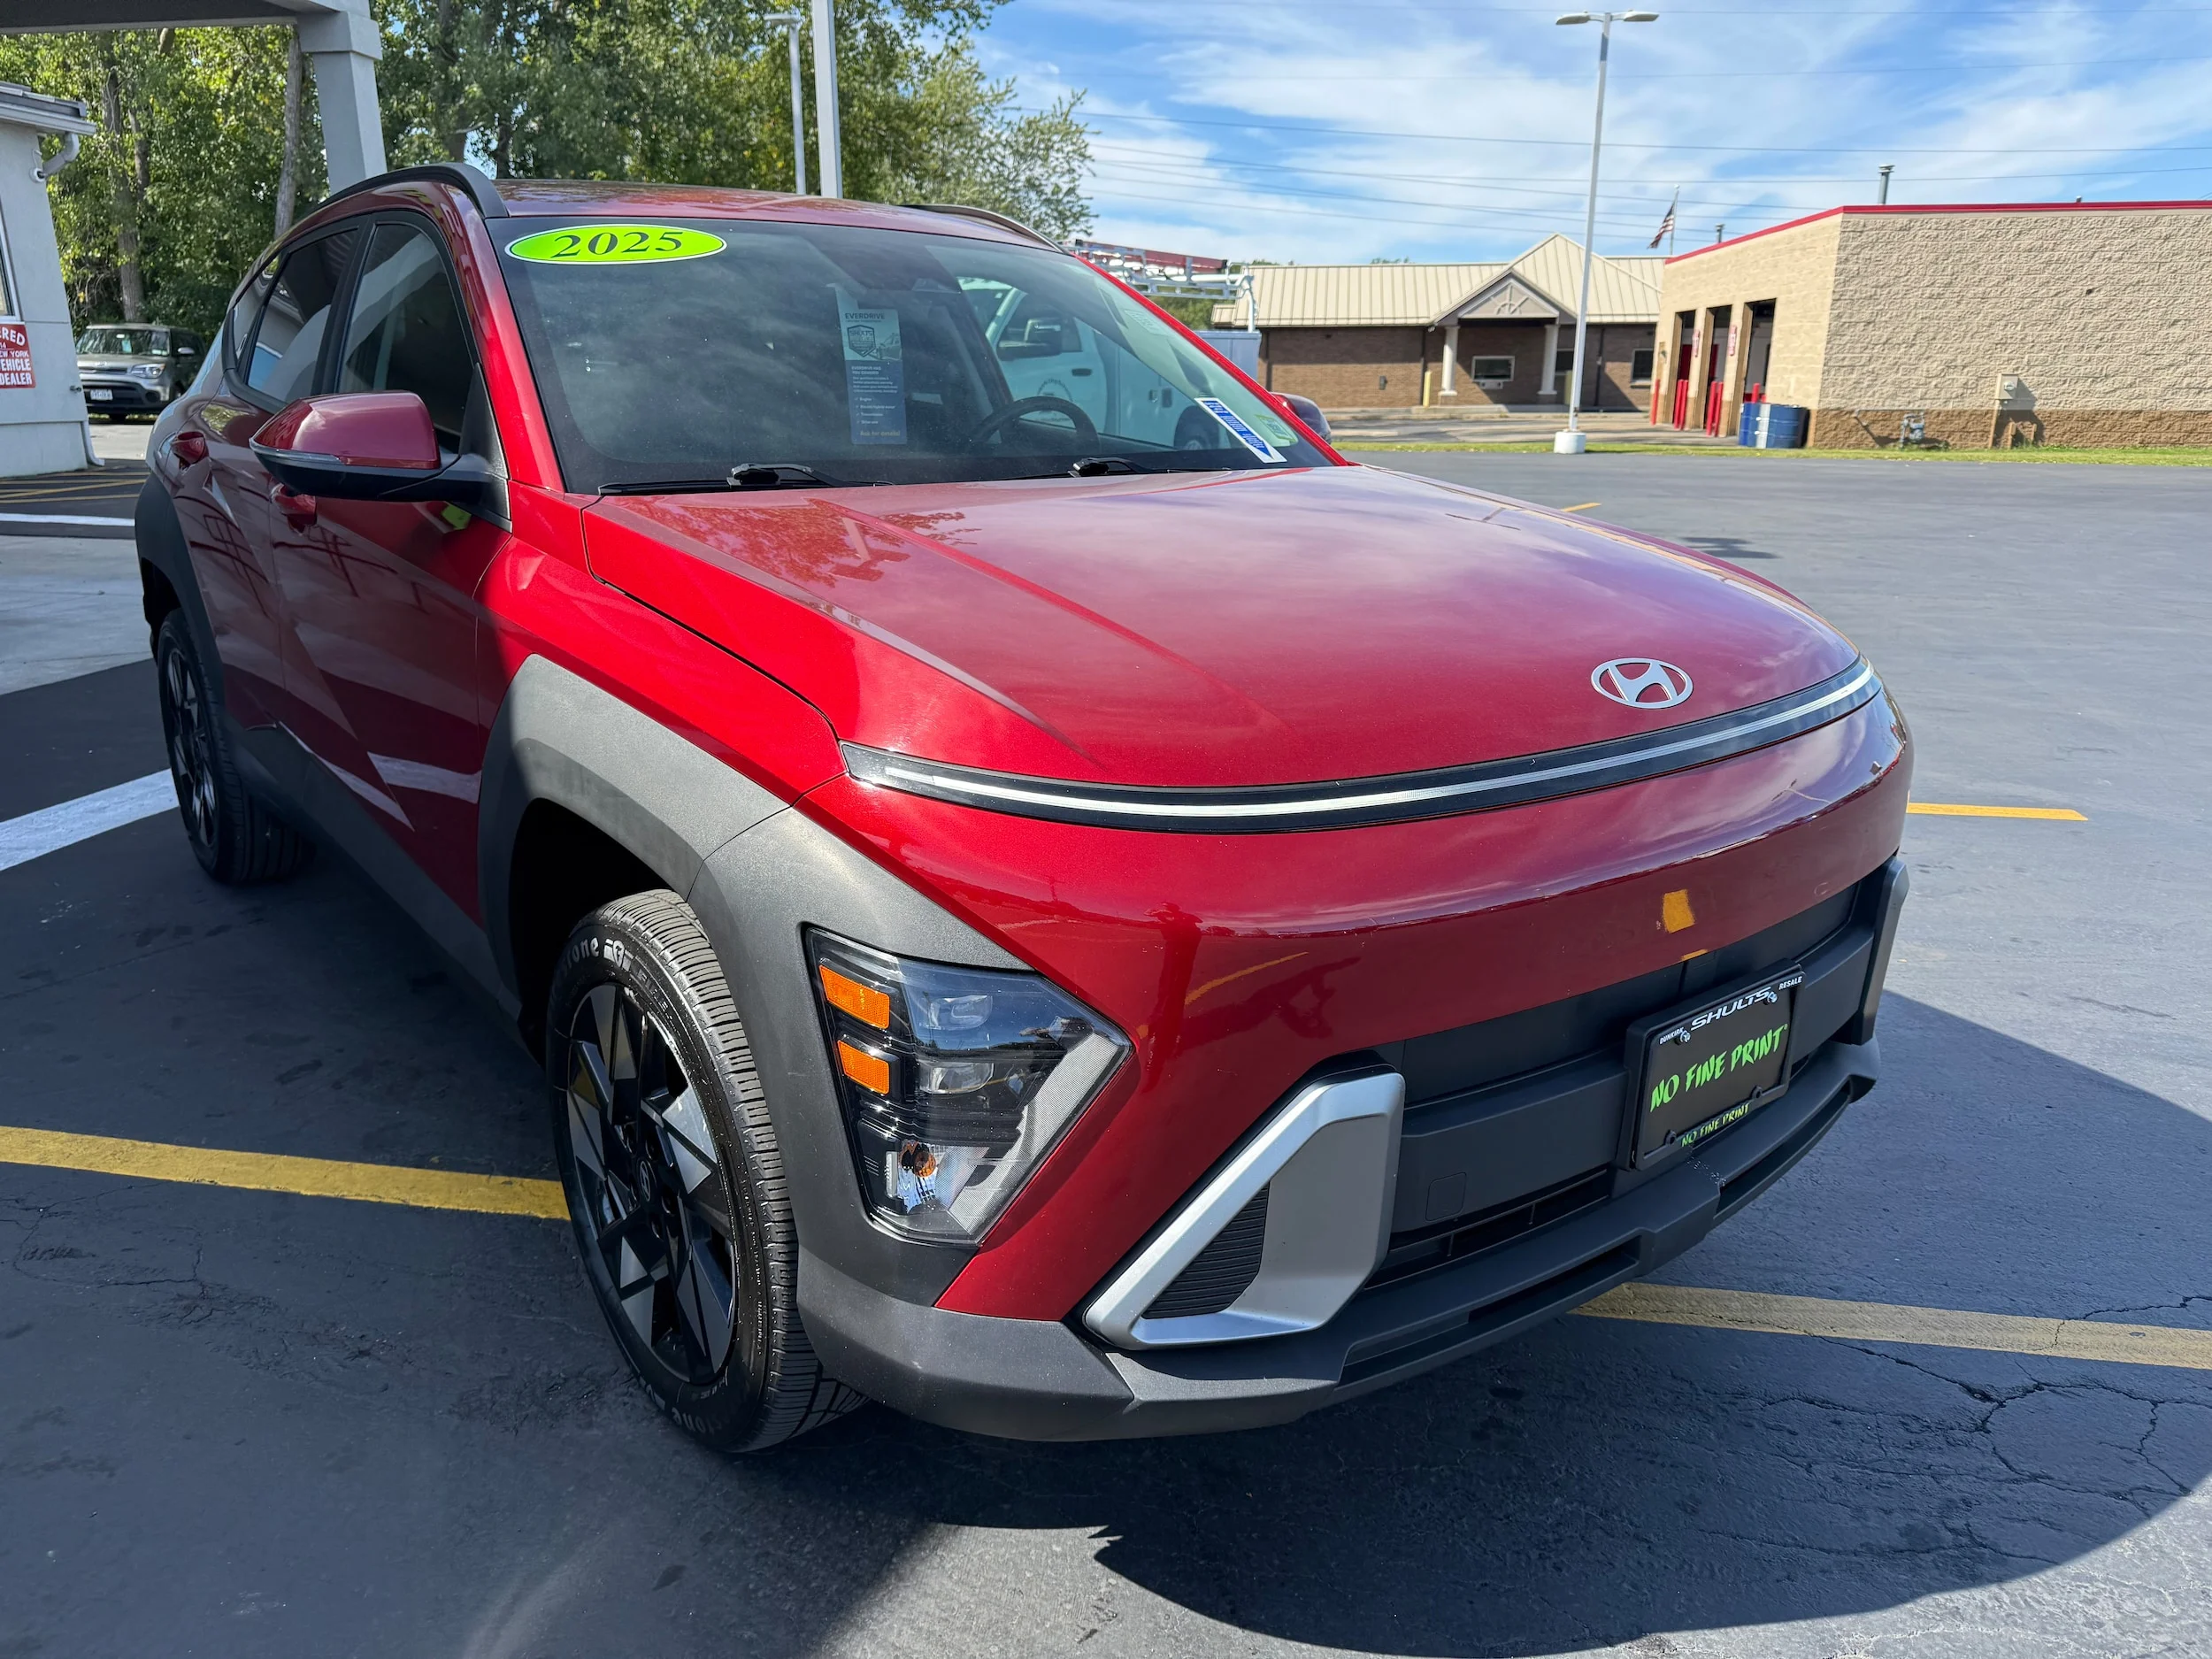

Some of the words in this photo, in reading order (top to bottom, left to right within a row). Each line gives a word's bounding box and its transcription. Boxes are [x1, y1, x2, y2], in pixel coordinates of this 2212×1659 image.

[550, 231, 684, 258] 2025
[0, 326, 26, 346] RED
[0, 358, 32, 371] EHICLE
[0, 373, 33, 386] DEALER
[1778, 976, 1803, 990] RESALE
[1691, 987, 1771, 1031] SHULTS
[1659, 1027, 1685, 1045] DUNKIRK
[1649, 1074, 1680, 1112] NO
[1686, 1050, 1727, 1093] FINE
[1681, 1131, 1698, 1148] NO
[1700, 1118, 1720, 1138] FINE
[1723, 1103, 1750, 1125] PRINT
